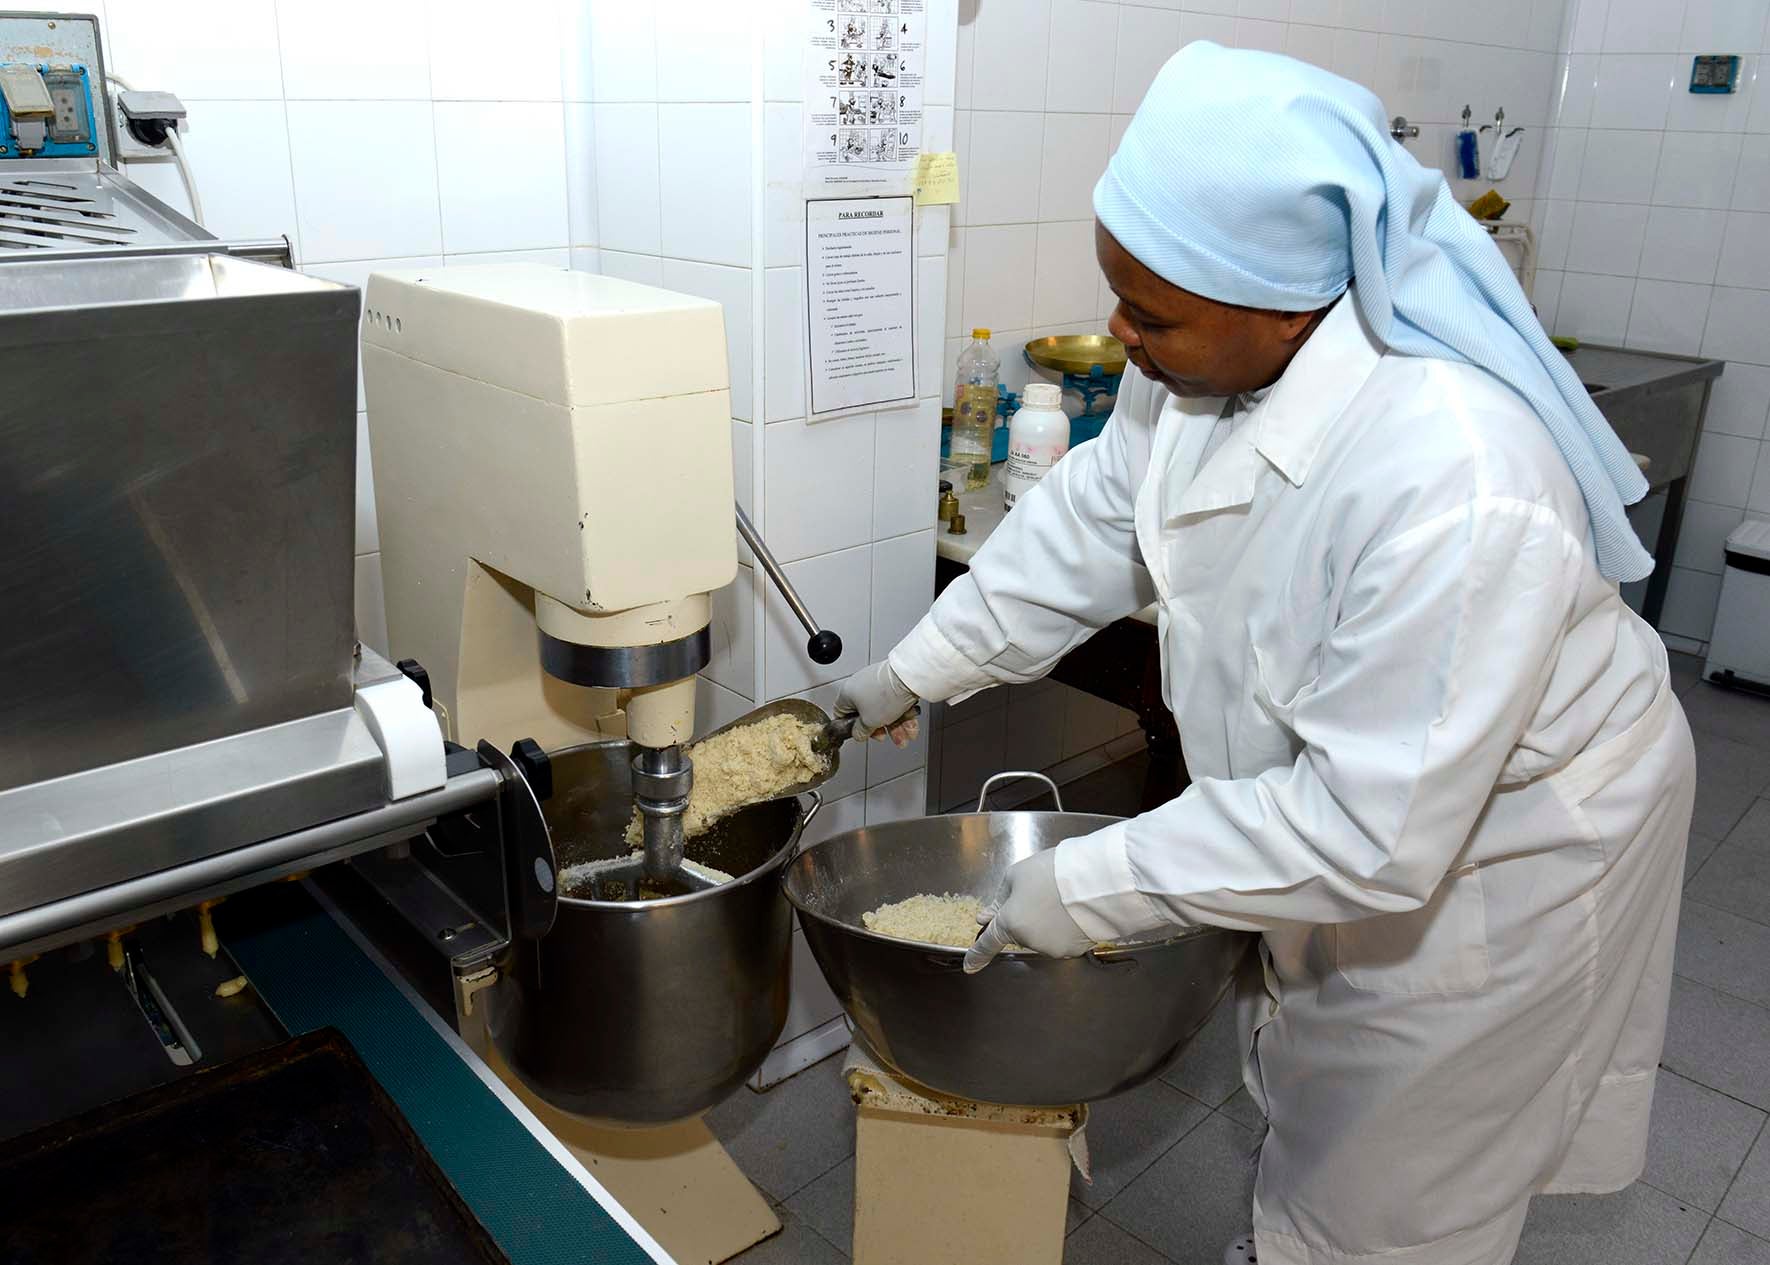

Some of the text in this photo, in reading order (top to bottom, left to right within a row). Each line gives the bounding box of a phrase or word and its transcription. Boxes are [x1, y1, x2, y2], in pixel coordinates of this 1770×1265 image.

[827, 19, 835, 32] 3
[900, 23, 908, 34] 4
[828, 60, 837, 71] 5
[899, 60, 906, 71] 6
[830, 96, 837, 108] 7
[899, 95, 906, 107] 8
[830, 134, 837, 146] 9
[899, 132, 909, 145] 10
[854, 210, 883, 218] RECORDAR
